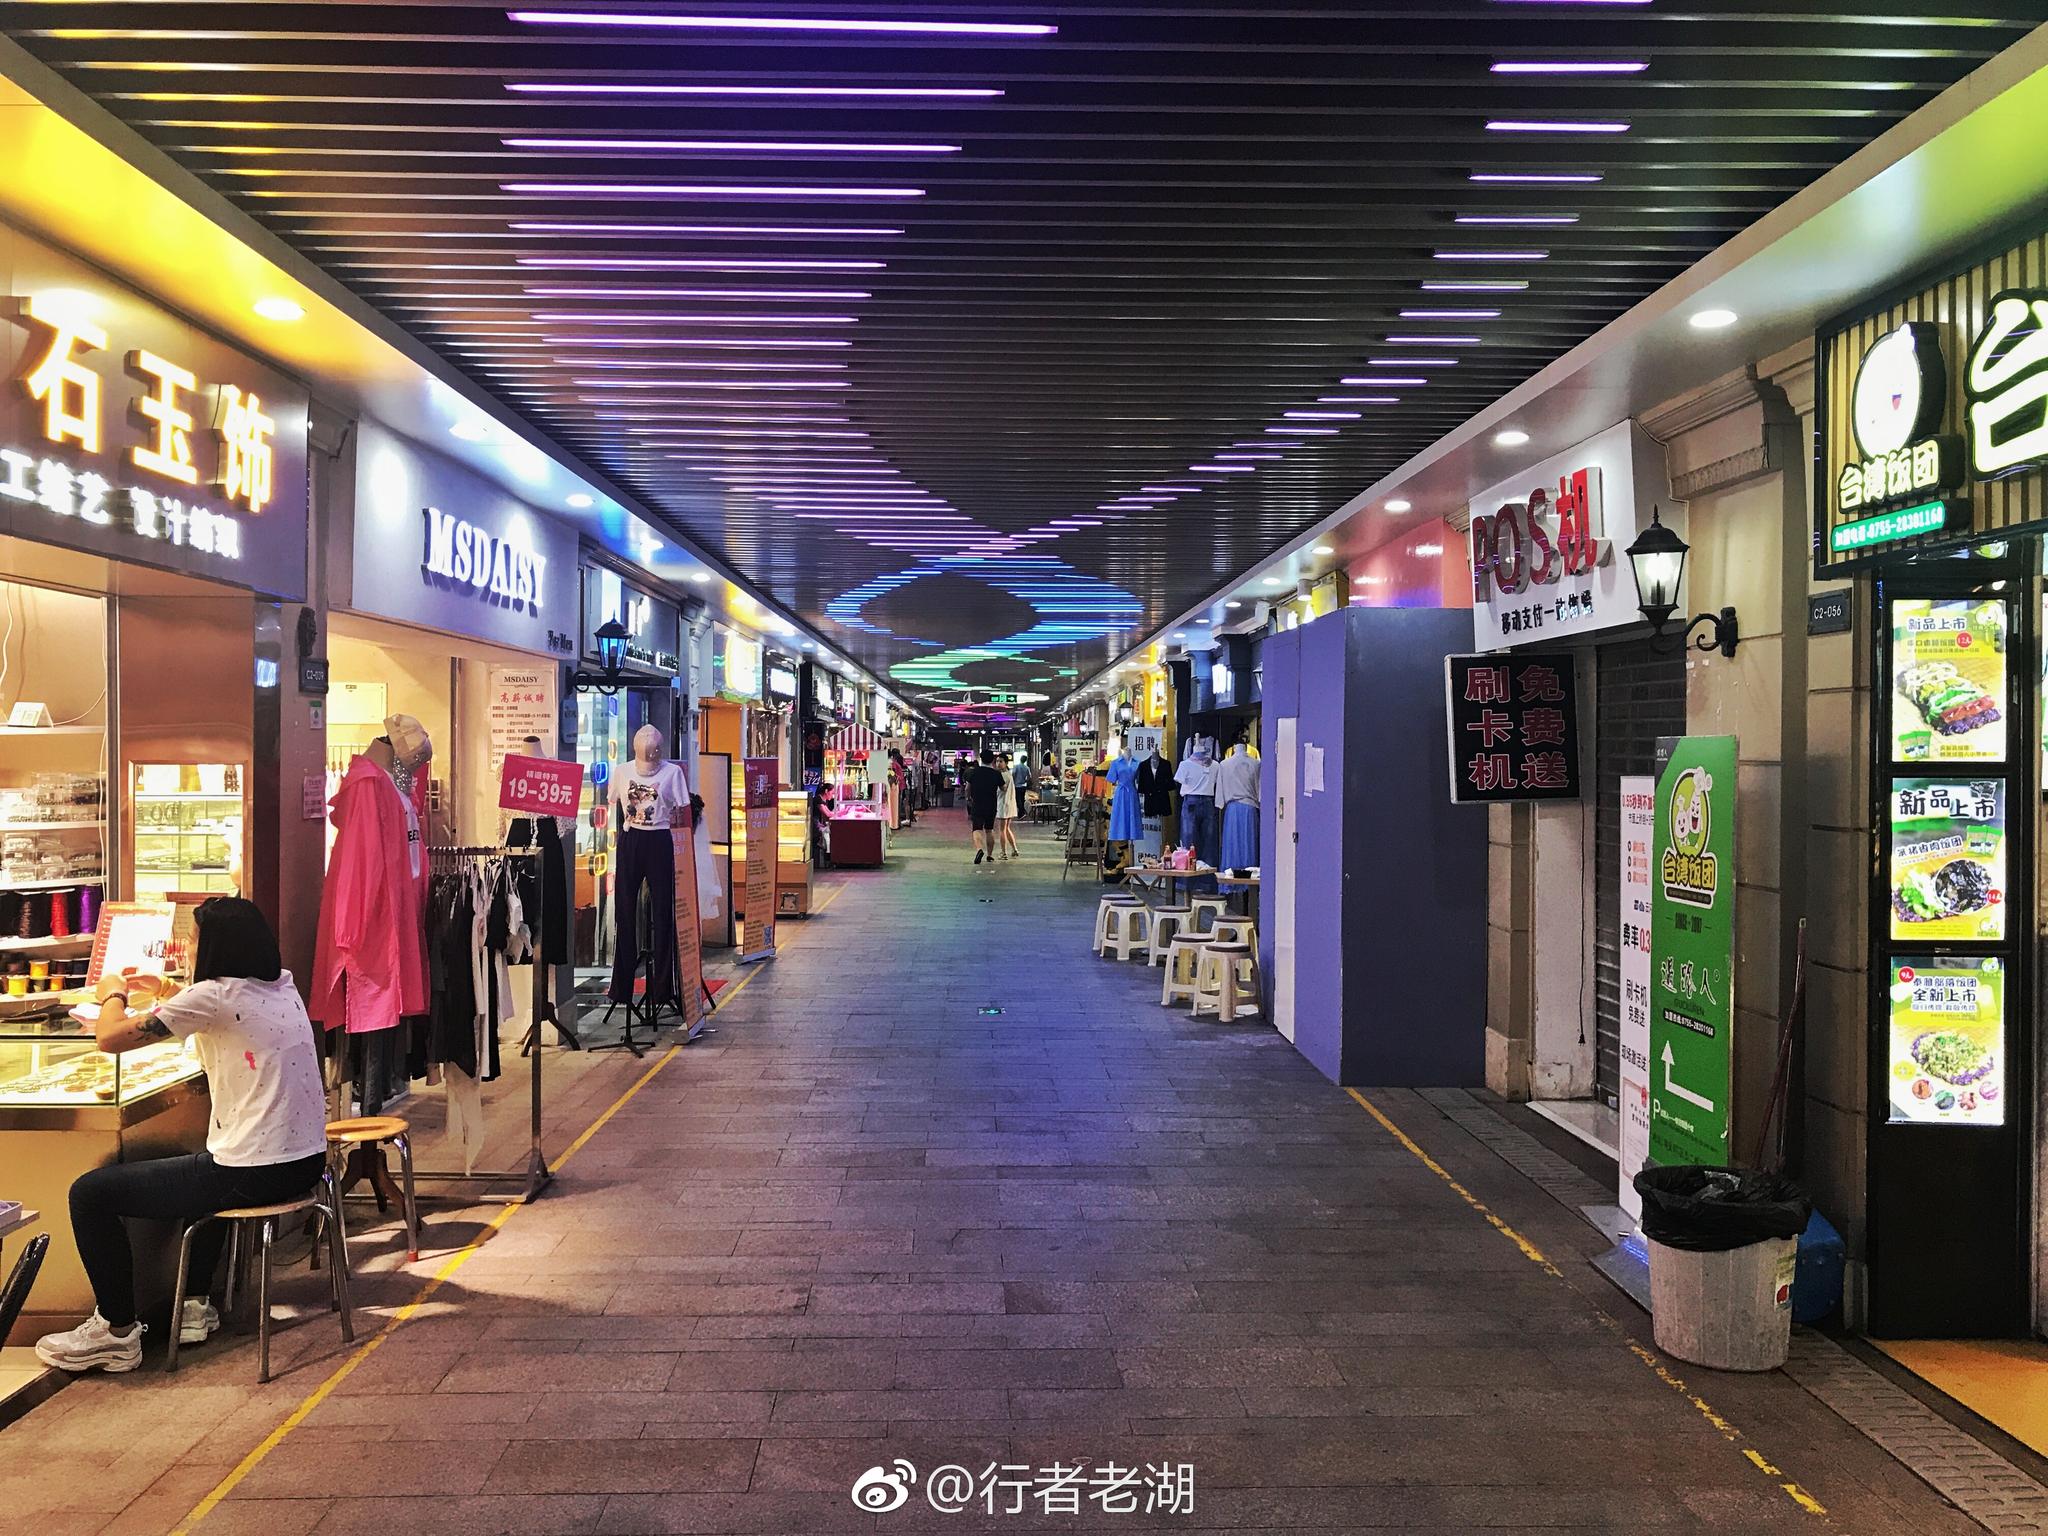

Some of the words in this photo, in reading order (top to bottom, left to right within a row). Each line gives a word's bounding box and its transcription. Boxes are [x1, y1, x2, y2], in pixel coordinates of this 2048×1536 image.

[1840, 440, 1938, 509] 台湾饭团
[1472, 467, 1600, 603] POS机
[426, 507, 547, 608] MSDAISY
[1814, 606, 1842, 620] C2-056
[1908, 617, 1966, 630] 新品上市
[1464, 666, 1518, 790] 刷卡机
[1516, 665, 1570, 790] 免费送
[508, 777, 573, 806] 19-39元
[1899, 788, 1995, 818] 新品上市
[1664, 851, 1715, 890] 台湾饭团
[1626, 979, 1648, 1008] 刷卡机
[1913, 988, 1976, 1002] 全新上市
